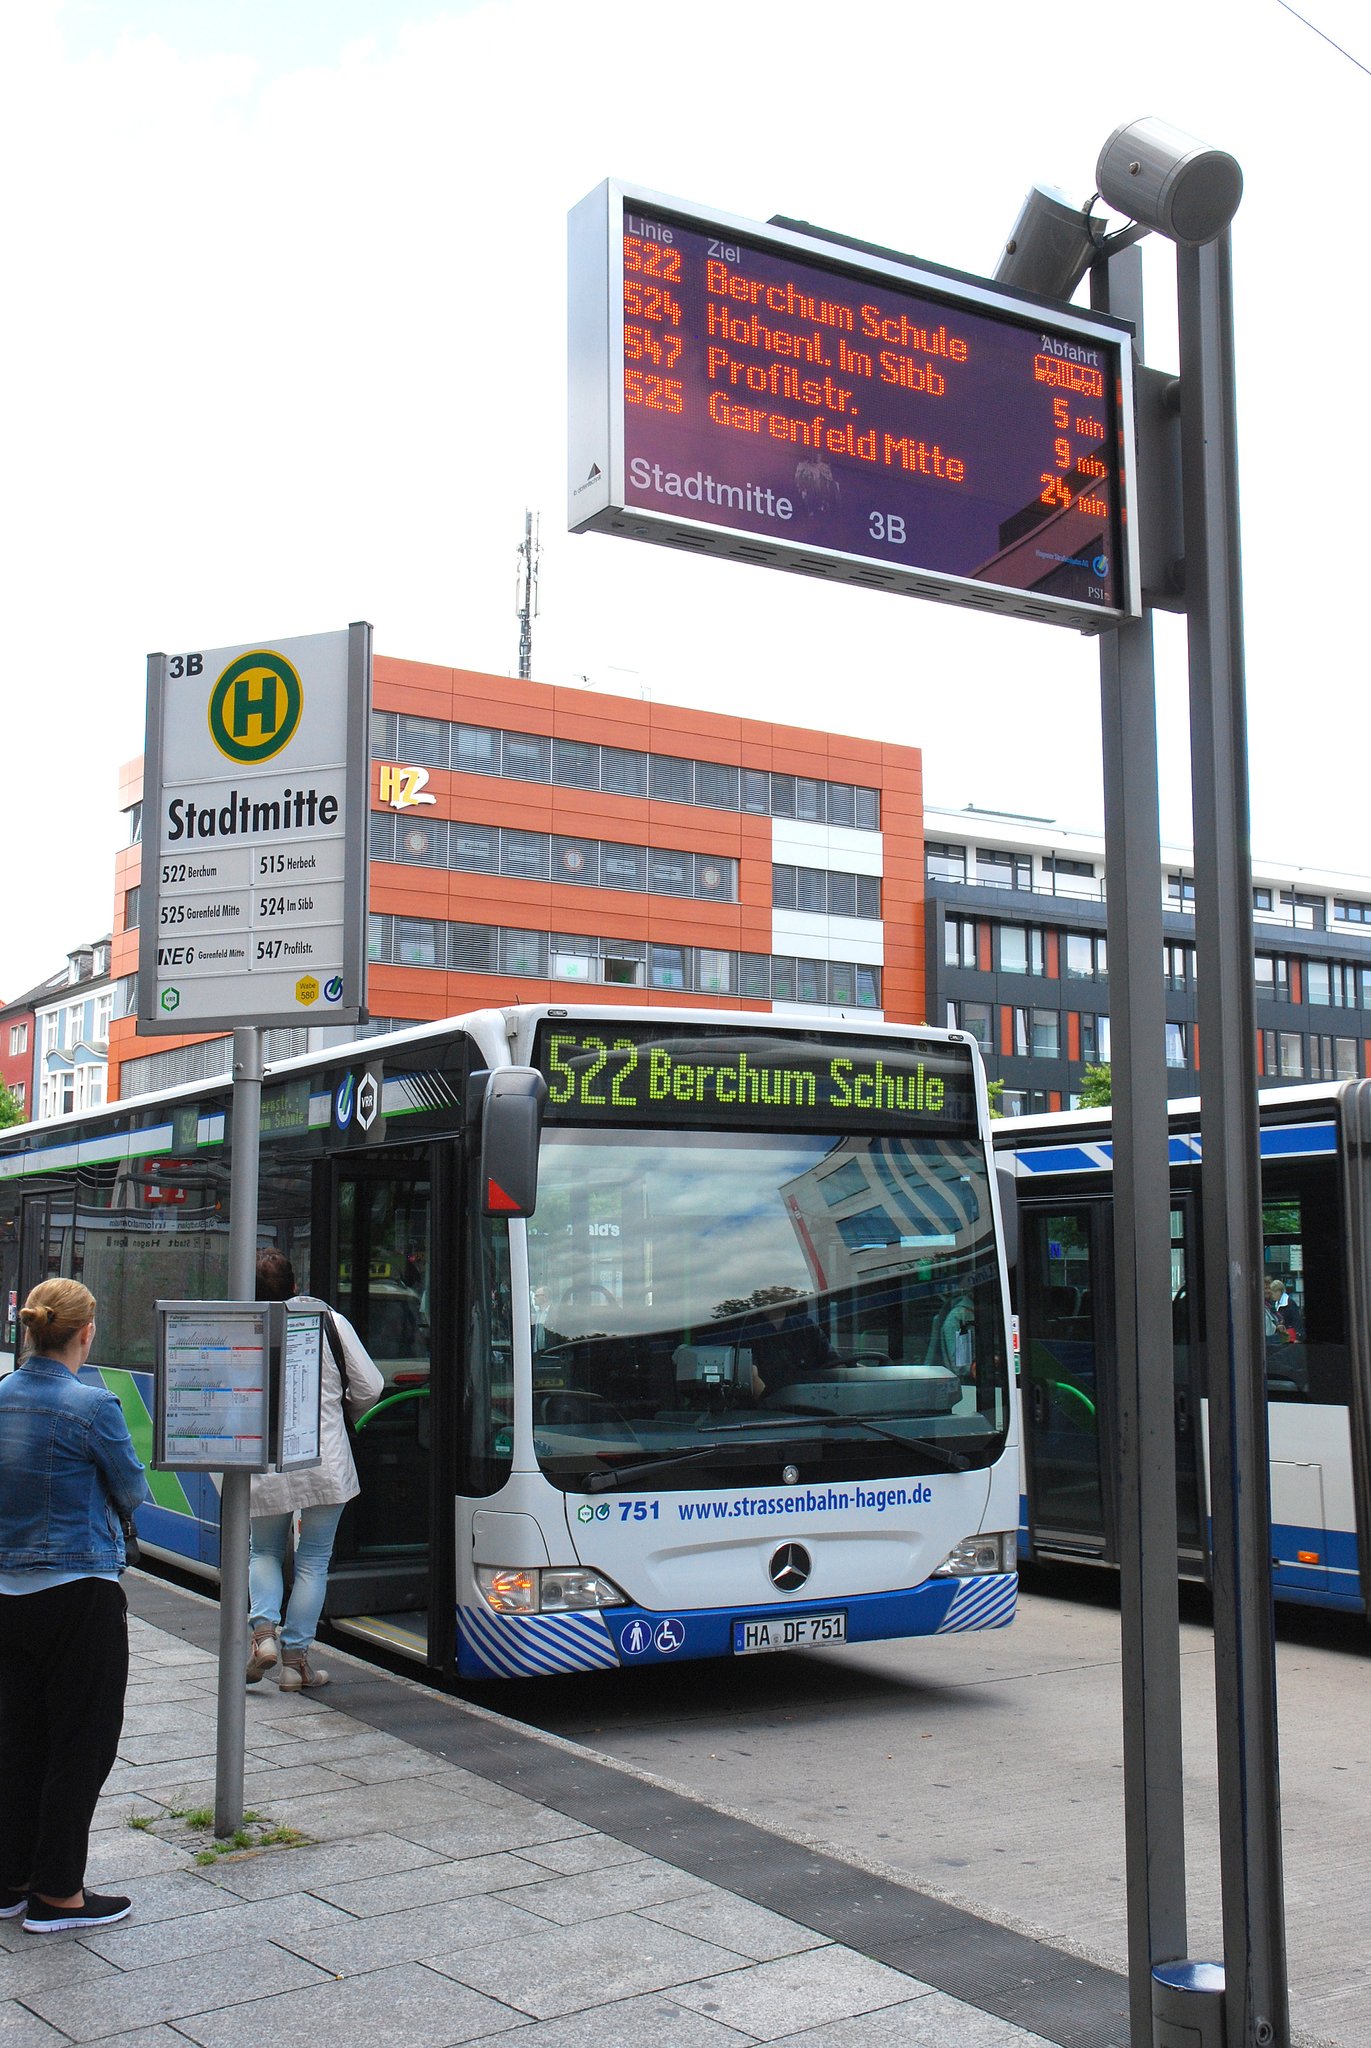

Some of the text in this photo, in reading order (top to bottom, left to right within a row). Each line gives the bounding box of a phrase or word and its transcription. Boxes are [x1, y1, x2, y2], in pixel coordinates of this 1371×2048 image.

[628, 215, 674, 243] Linie
[624, 236, 681, 283] 522
[707, 238, 740, 263] Ziel
[624, 280, 682, 326] 524
[707, 260, 967, 362] Berchum Schule
[624, 325, 682, 368] 547
[708, 303, 945, 396] Hohenl. Im Sibb
[1041, 336, 1098, 366] Abfahrt
[625, 369, 683, 414] 525
[709, 346, 858, 415] Profilstr.
[709, 391, 965, 482] Garenfeld Mitte
[1053, 398, 1104, 439] 5 min
[1055, 438, 1106, 478] 9 min
[630, 457, 793, 520] Stadtmitte
[1040, 473, 1107, 517] 24 min
[869, 511, 907, 544] 3B
[169, 653, 204, 679] 3B
[233, 676, 277, 737] H
[168, 788, 339, 841] Stadtmitte
[162, 864, 217, 883] 522 Berchum
[260, 854, 316, 875] 515 Herbeck
[160, 904, 240, 924] 525 Garenfeld Mitte
[259, 896, 314, 916] 524 Im Sibb
[198, 950, 228, 960] Garenfeld
[229, 948, 245, 958] Mitte
[256, 940, 313, 960] 547 Profilstr.
[300, 990, 315, 1000] 580
[550, 1035, 944, 1110] 522 Berchum Schule
[361, 1096, 373, 1107] VRR
[618, 1500, 660, 1521] 751
[678, 1483, 932, 1521] www.strassenbahn-hagen.de
[746, 1617, 843, 1647] HA DF 751
